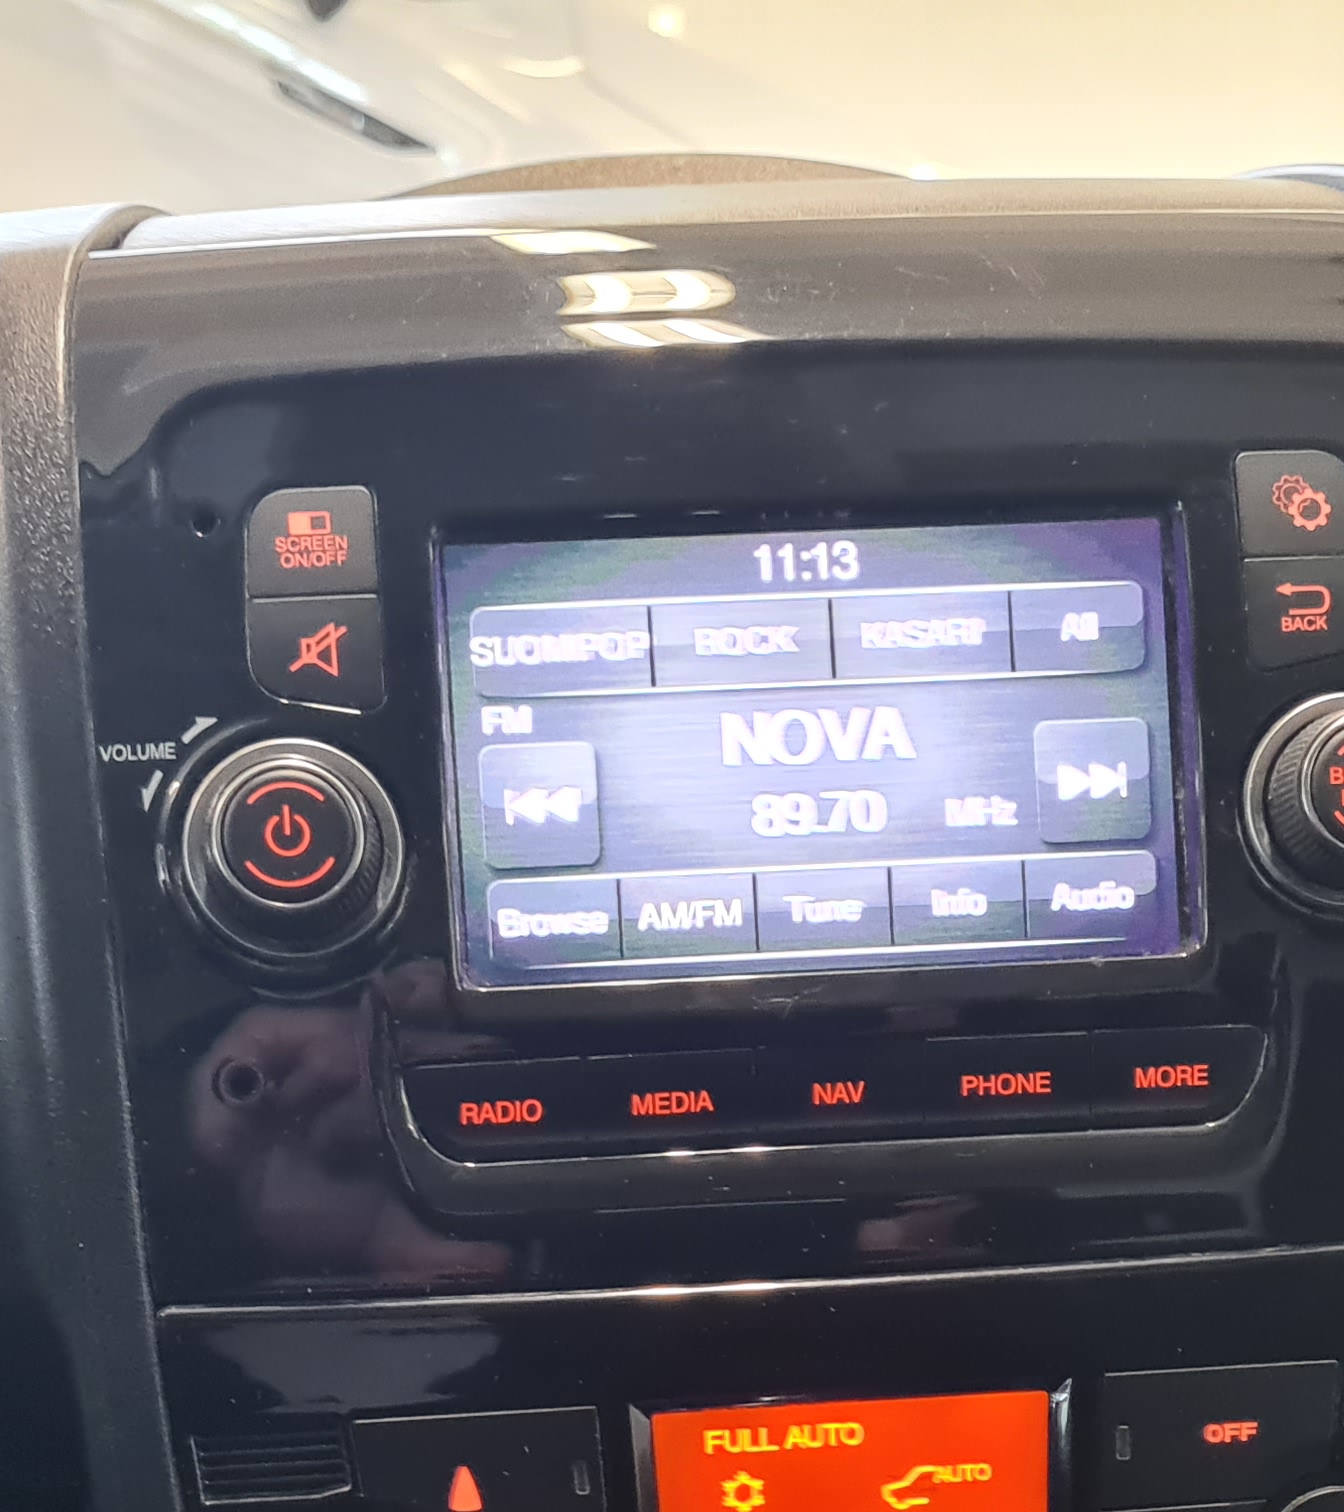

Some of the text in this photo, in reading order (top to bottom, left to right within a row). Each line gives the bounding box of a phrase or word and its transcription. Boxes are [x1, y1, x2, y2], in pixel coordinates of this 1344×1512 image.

[274, 533, 348, 553] SCREEN
[279, 552, 348, 569] ON/OFF
[753, 540, 860, 584] 11:13
[1281, 616, 1328, 633] BACK
[693, 626, 800, 656] ROCK
[481, 705, 533, 735] FM
[719, 706, 918, 766] NOVA
[99, 742, 177, 763] VOLUME
[750, 789, 1019, 837] 89.70 MHz
[782, 895, 867, 923] Tune
[931, 888, 988, 917] Info
[1050, 882, 1135, 911] Audio
[497, 907, 609, 938] Browse
[637, 898, 743, 931] AM/FM
[960, 1072, 1052, 1096] PHONE
[1133, 1064, 1209, 1088] MORE
[630, 1090, 714, 1116] MEDIA
[811, 1081, 865, 1105] NAV
[460, 1099, 544, 1125] RADIO
[704, 1422, 865, 1454] FULL AUTO
[1203, 1421, 1258, 1443] OFF
[932, 1462, 992, 1484] AUTO
